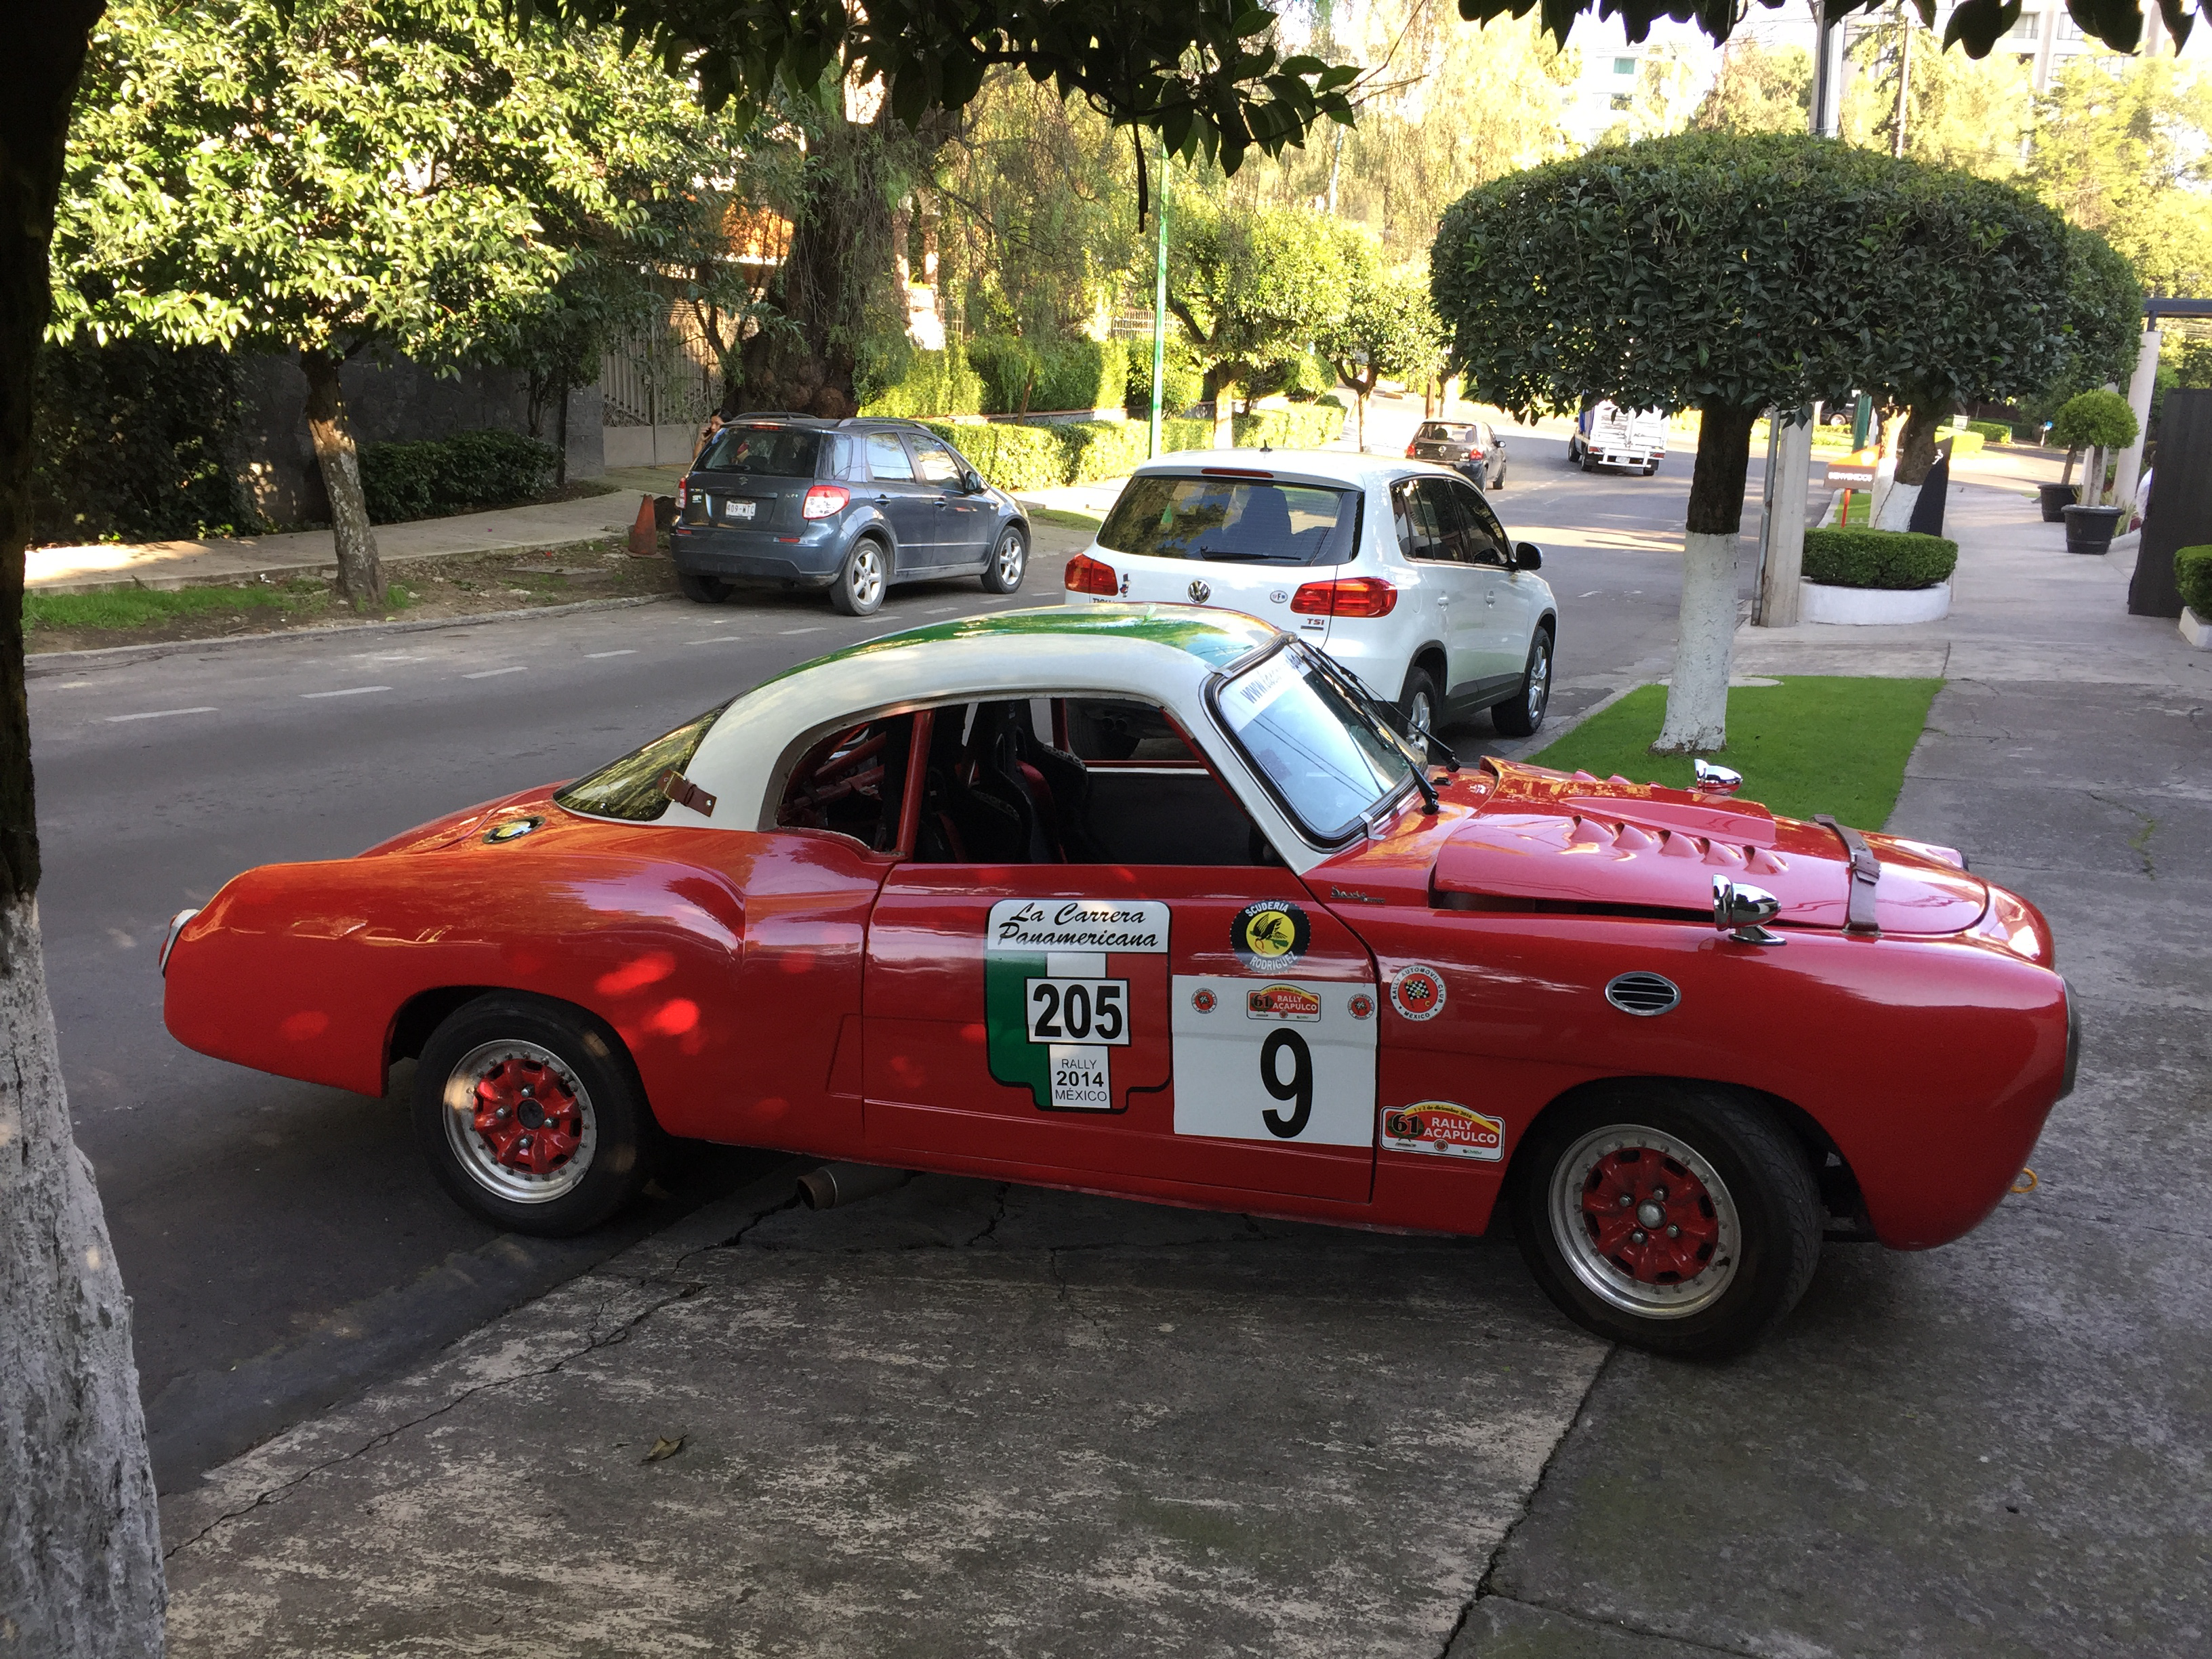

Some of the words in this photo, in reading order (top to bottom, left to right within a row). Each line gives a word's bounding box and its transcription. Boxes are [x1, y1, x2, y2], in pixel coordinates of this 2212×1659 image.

[1009, 902, 1045, 922] La
[1054, 902, 1146, 926] Carrera
[1245, 901, 1289, 917] SCUDERIA
[997, 922, 1158, 947] Panamericana
[1249, 950, 1298, 970] RODRIGUEZ
[1392, 978, 1401, 1000] RALLY
[1401, 967, 1439, 983] AUTOMOVIL
[1253, 994, 1270, 1008] 61
[1272, 1003, 1317, 1011] ACAPULCO
[1032, 983, 1122, 1040] 205
[1062, 1059, 1097, 1070] RALLY
[1056, 1070, 1104, 1088] 2014
[1260, 1027, 1313, 1139] 9
[1055, 1087, 1107, 1102] MÉXICO
[1392, 1113, 1418, 1135] 61
[1431, 1117, 1473, 1130] RALLY
[1423, 1128, 1497, 1143] ACAPULCO
